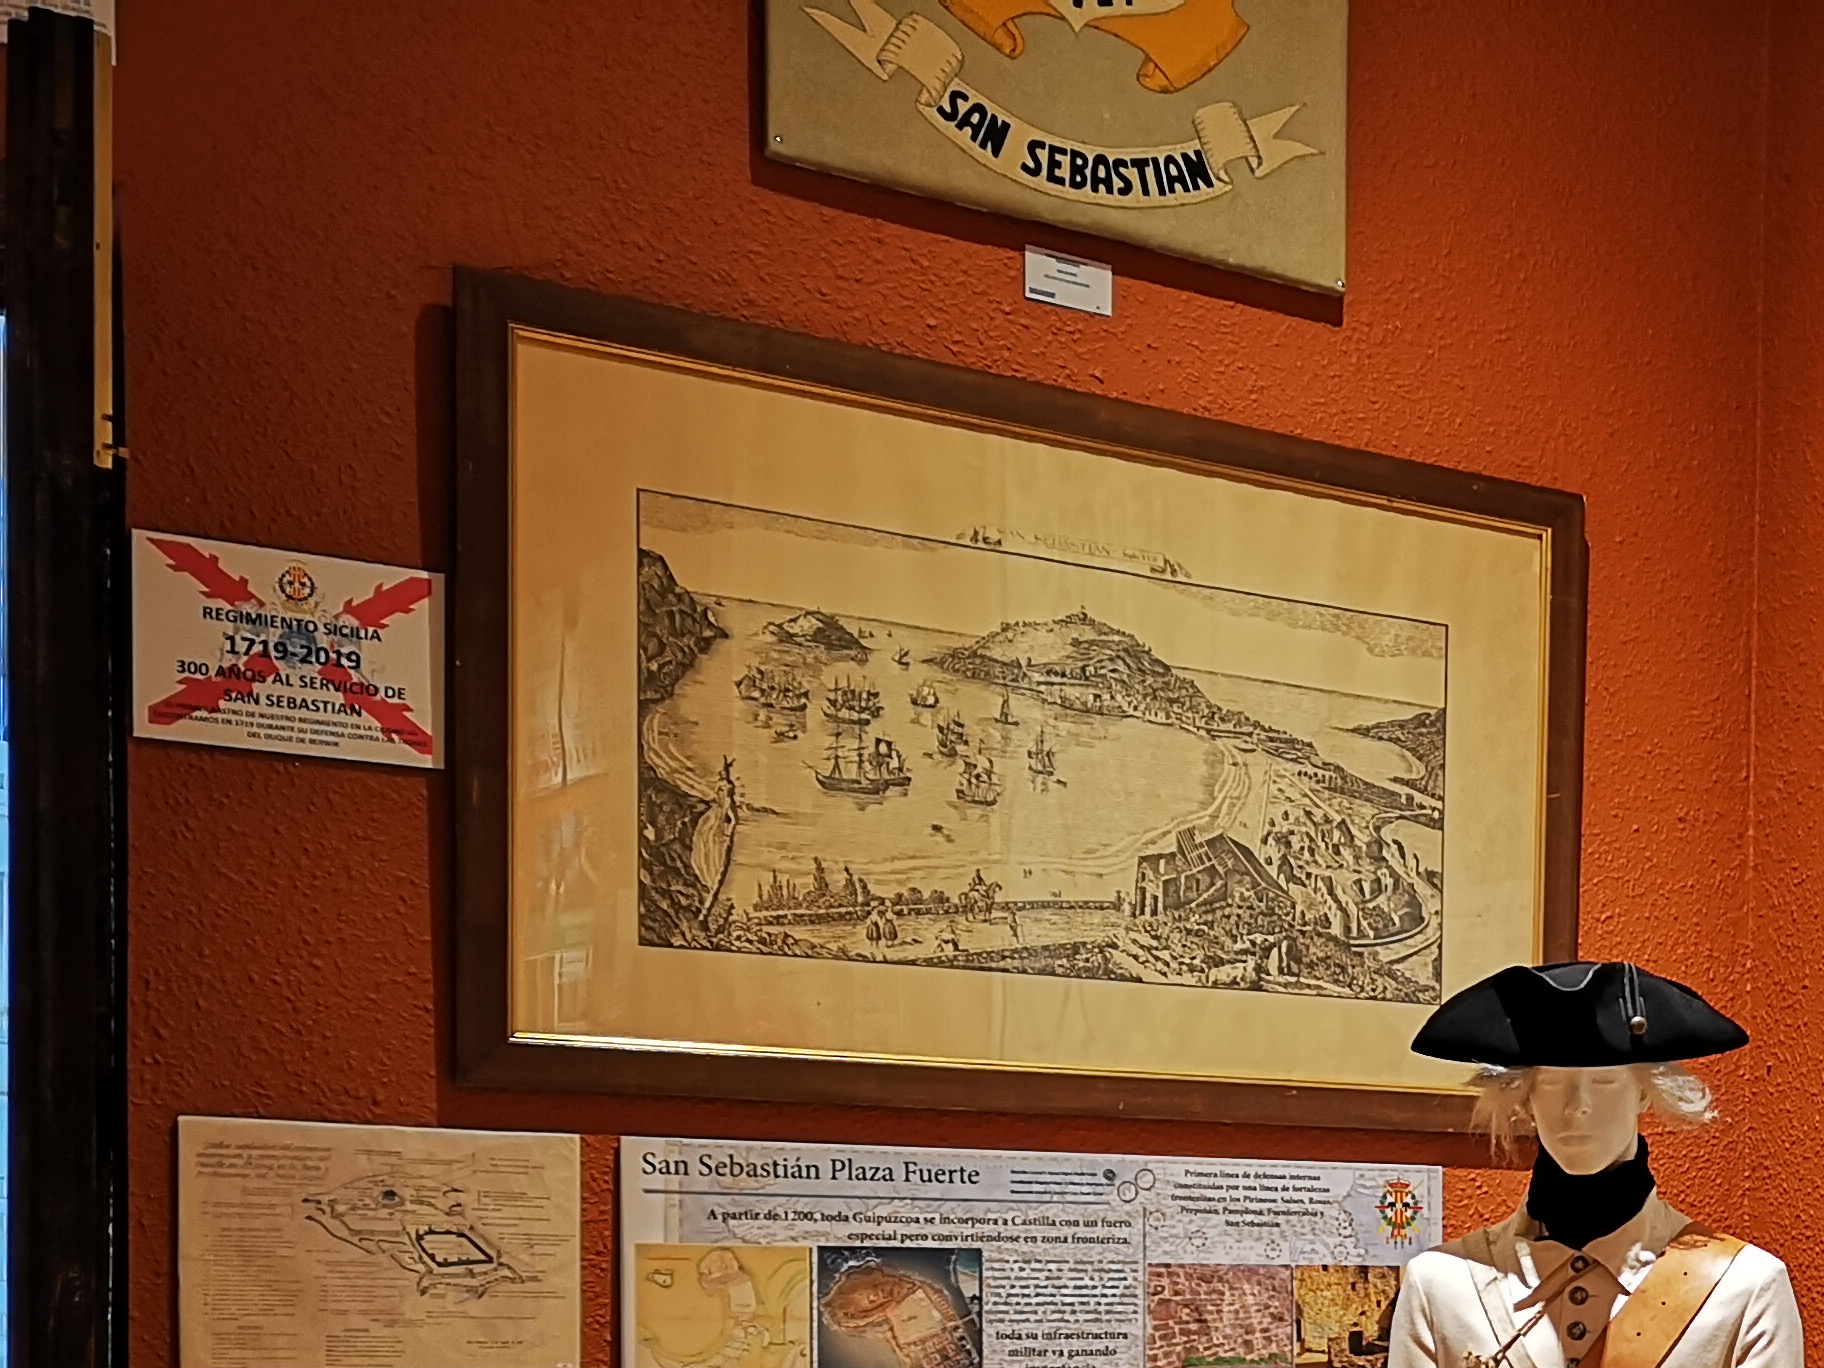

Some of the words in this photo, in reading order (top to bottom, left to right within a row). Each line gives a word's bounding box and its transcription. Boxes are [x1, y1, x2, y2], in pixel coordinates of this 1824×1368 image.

[936, 89, 1011, 158] SAN
[1021, 140, 1214, 197] SEBASTIAN
[202, 606, 318, 634] REGIMIENTO
[322, 622, 382, 642] SICILIA
[224, 635, 361, 669] 1719-2019
[176, 660, 209, 676] 300
[214, 663, 266, 684] AÑOS
[271, 672, 294, 687] AL
[298, 675, 379, 697] SERVICIO
[384, 685, 406, 700] DE
[223, 689, 260, 705] SAN
[265, 694, 362, 718] SEBASTIAN
[641, 1151, 689, 1177] San
[699, 1152, 821, 1181] Sebastián
[829, 1157, 894, 1183] Plaza
[903, 1161, 981, 1186] Fuerte
[706, 1207, 718, 1220] A
[721, 1208, 761, 1225] partir
[764, 1208, 780, 1222] de
[820, 1210, 850, 1222] toda
[923, 1214, 936, 1225] se
[938, 1211, 999, 1228] incorpora
[1001, 1216, 1009, 1226] a
[1011, 1214, 1057, 1228] Castilla
[1059, 1218, 1080, 1228] con
[1083, 1218, 1099, 1228] un
[1101, 1215, 1132, 1229] fuero
[847, 1230, 898, 1245] especial
[901, 1232, 929, 1246] pero
[1024, 1234, 1038, 1244] en
[1040, 1234, 1069, 1244] zona
[1071, 1233, 1132, 1245] fronteriza.
[995, 1329, 1023, 1340] toda
[1025, 1332, 1038, 1340] su
[1041, 1328, 1129, 1340] infraestructura
[1007, 1346, 1049, 1358] militar
[1051, 1348, 1064, 1357] va
[1067, 1345, 1118, 1360] ganando
